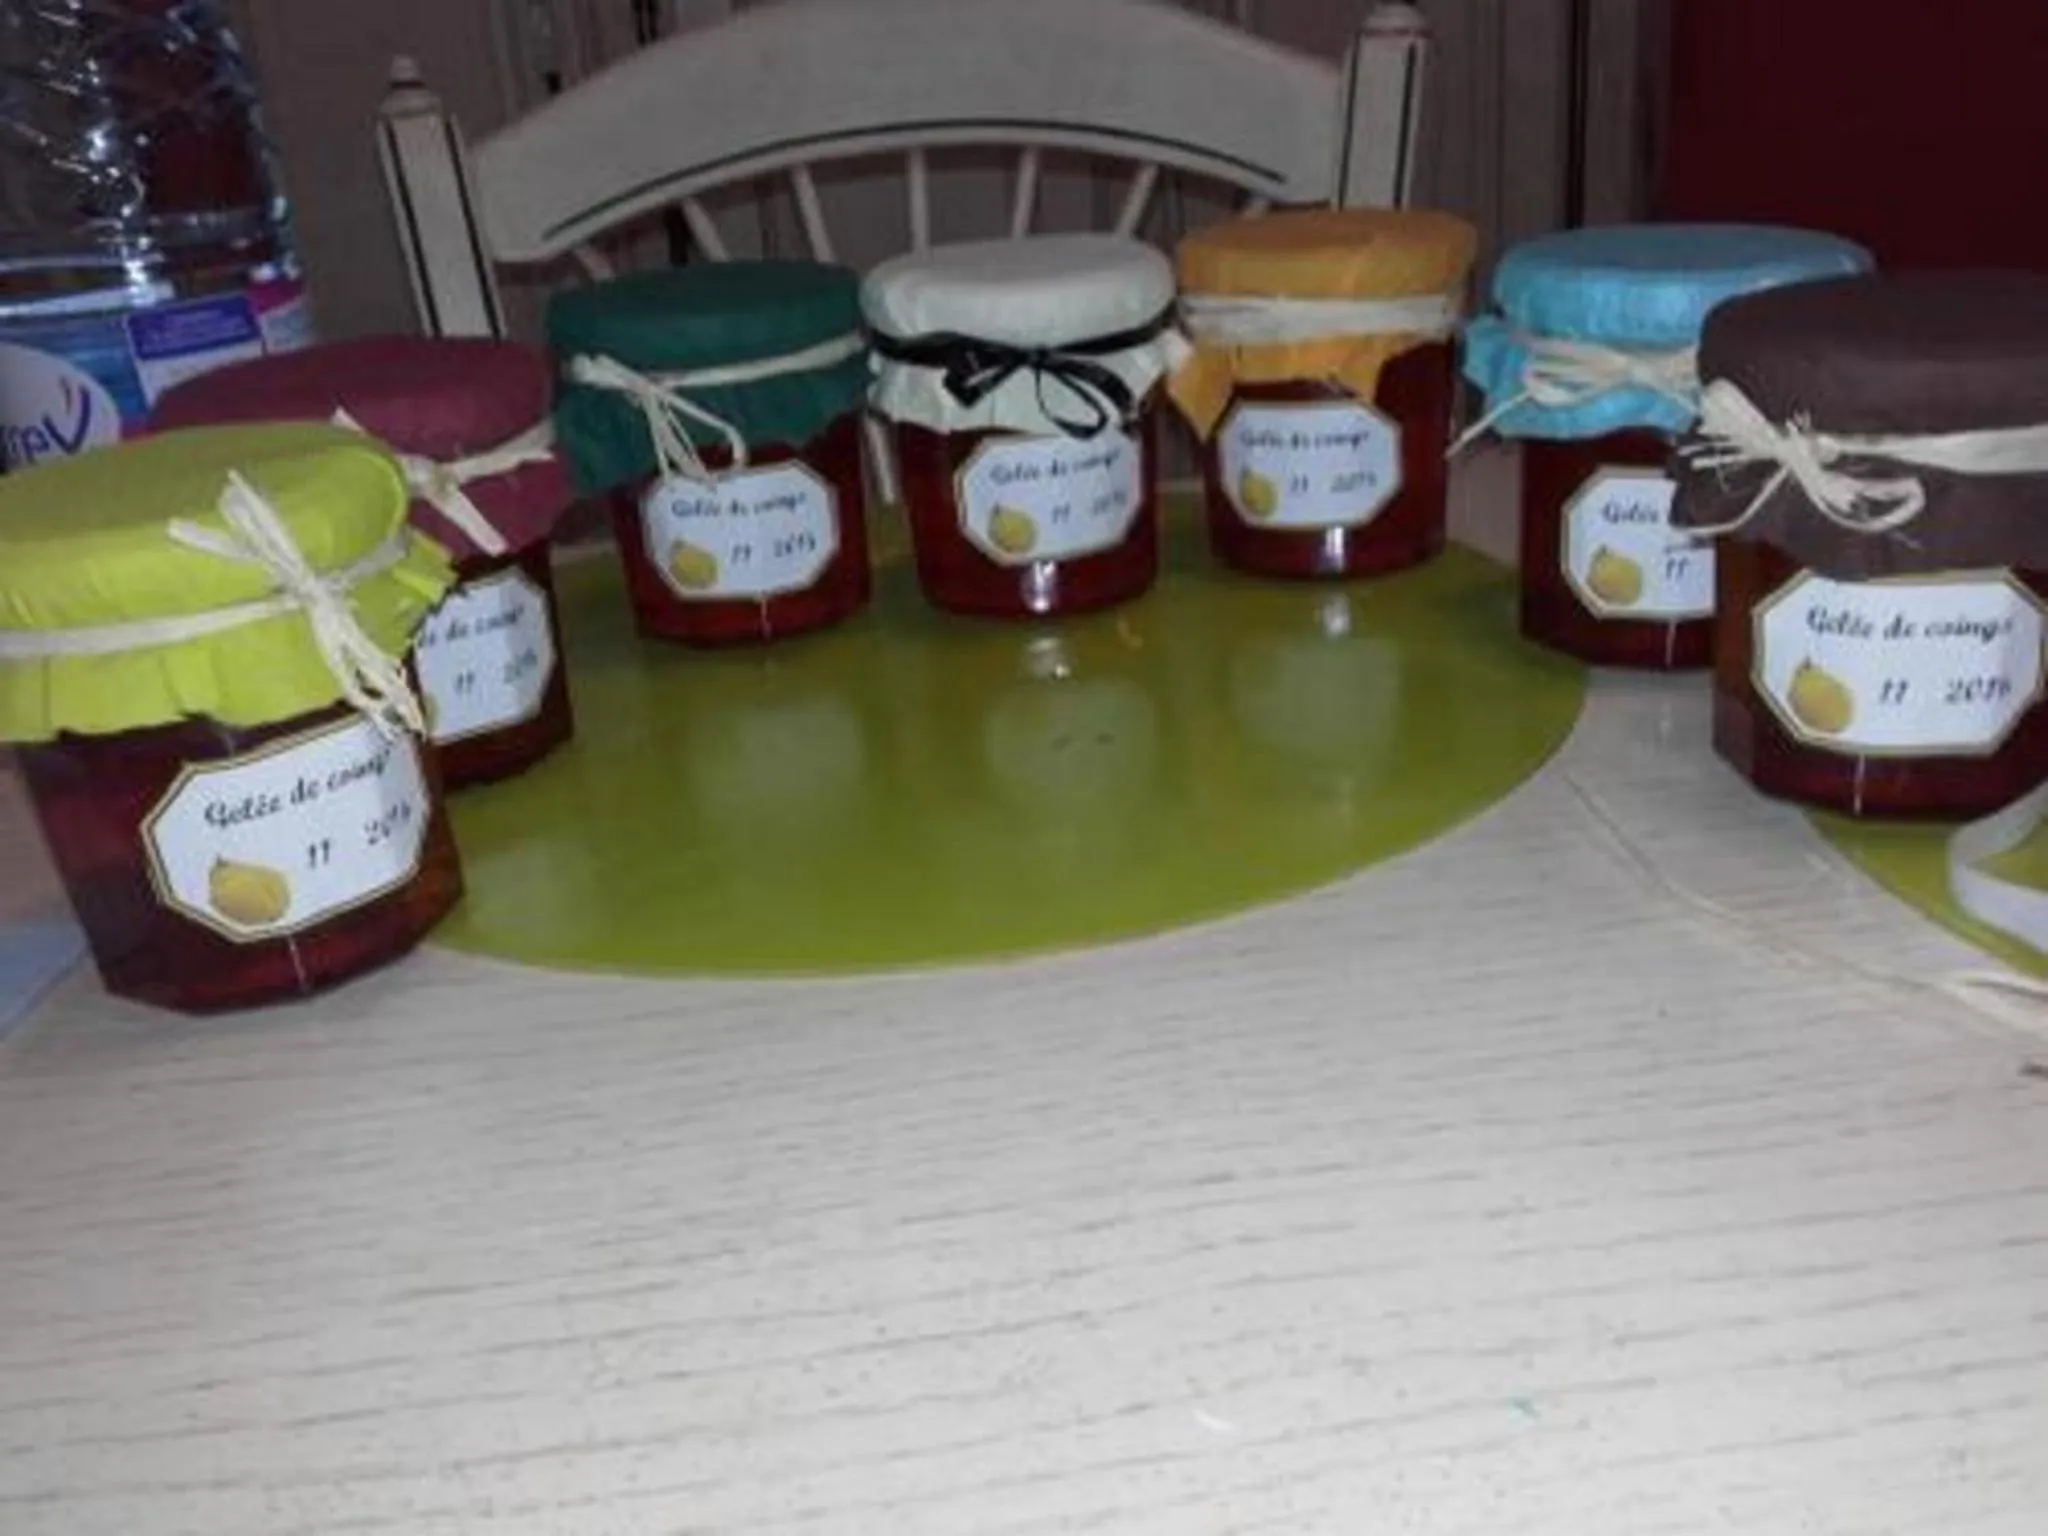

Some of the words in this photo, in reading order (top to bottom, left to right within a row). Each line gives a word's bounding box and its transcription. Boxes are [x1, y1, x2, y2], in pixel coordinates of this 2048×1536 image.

[1289, 431, 1310, 448] de
[1047, 457, 1068, 478] de
[729, 499, 748, 517] de
[1805, 603, 1874, 640] Gelée
[1882, 610, 1913, 641] de
[1880, 676, 1909, 705] 11
[204, 794, 281, 830] Gelée
[289, 776, 321, 805] de
[308, 838, 331, 869] 11
